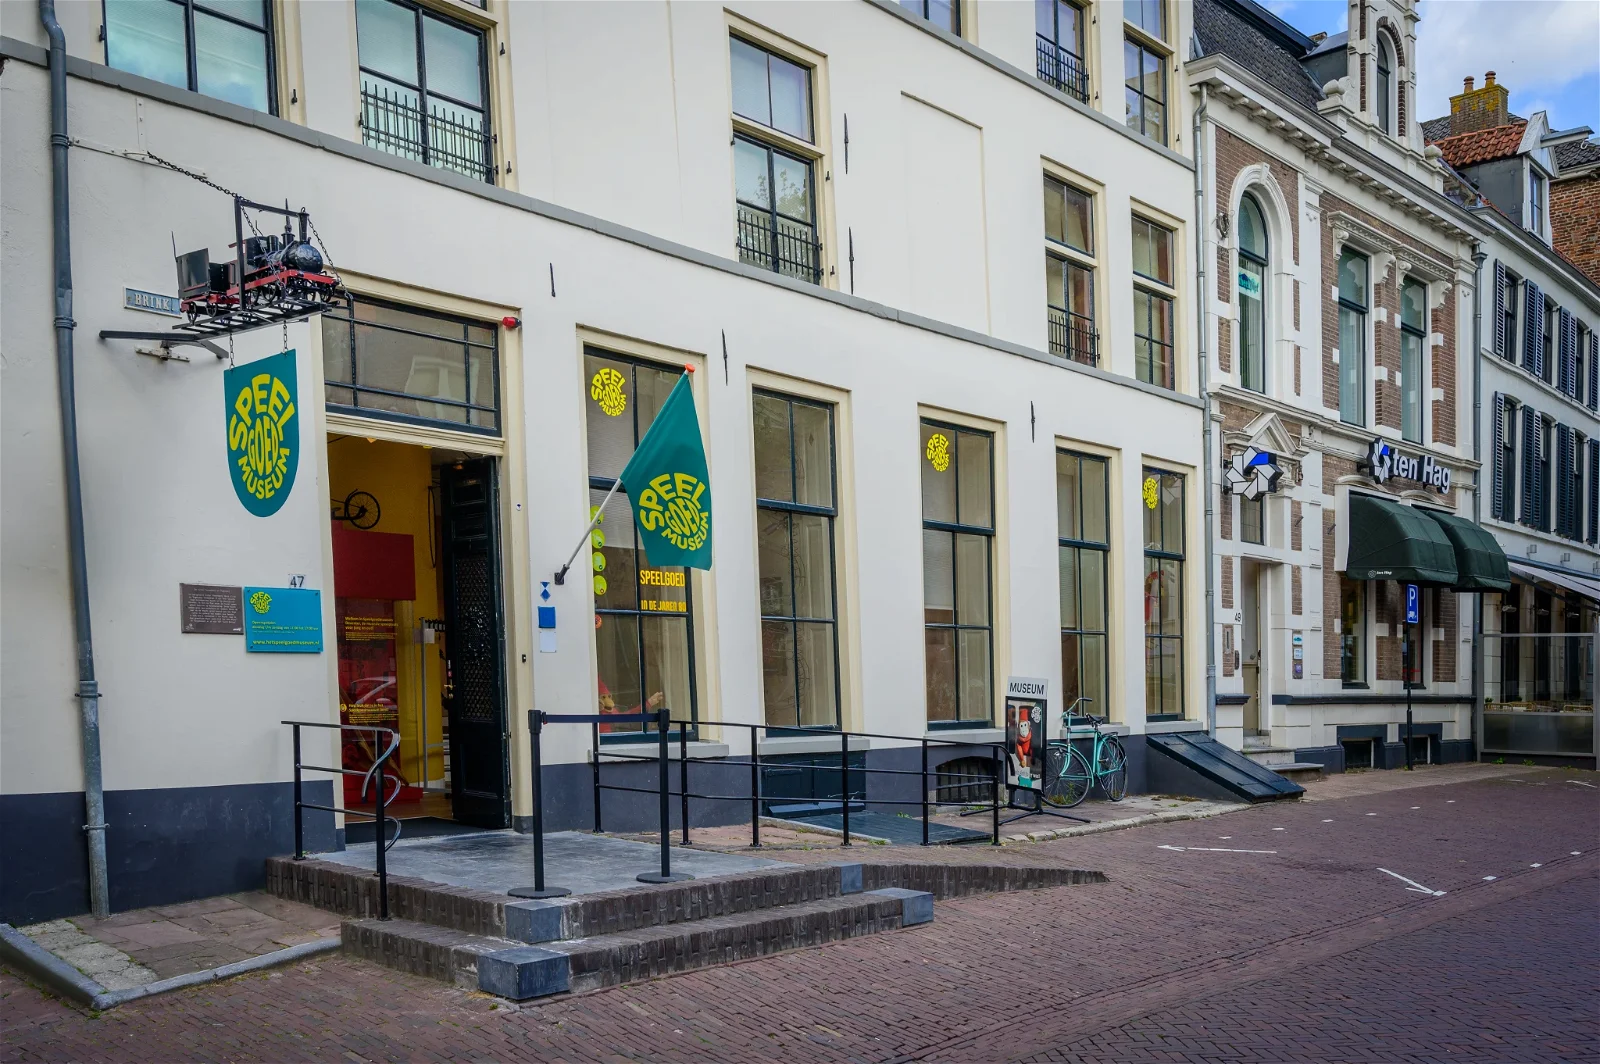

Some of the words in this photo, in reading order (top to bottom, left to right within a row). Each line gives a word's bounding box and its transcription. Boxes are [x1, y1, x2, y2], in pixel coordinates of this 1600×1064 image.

[590, 368, 626, 400] SPEEL
[603, 384, 621, 407] GOED
[230, 374, 296, 451] SPEEL
[599, 394, 626, 416] MUSEUM
[248, 416, 279, 476] GOED
[926, 433, 949, 460] SPEEL
[238, 448, 290, 500] MUSEUM
[1393, 448, 1418, 480] ten
[1422, 455, 1452, 494] Hag
[638, 472, 706, 530] SPEEL
[664, 498, 700, 536] GOED
[661, 512, 708, 550] MUSEUM
[290, 576, 304, 588] 47
[640, 570, 685, 587] SPEELGOED
[1409, 588, 1416, 606] P
[1009, 682, 1044, 695] MUSEUM
